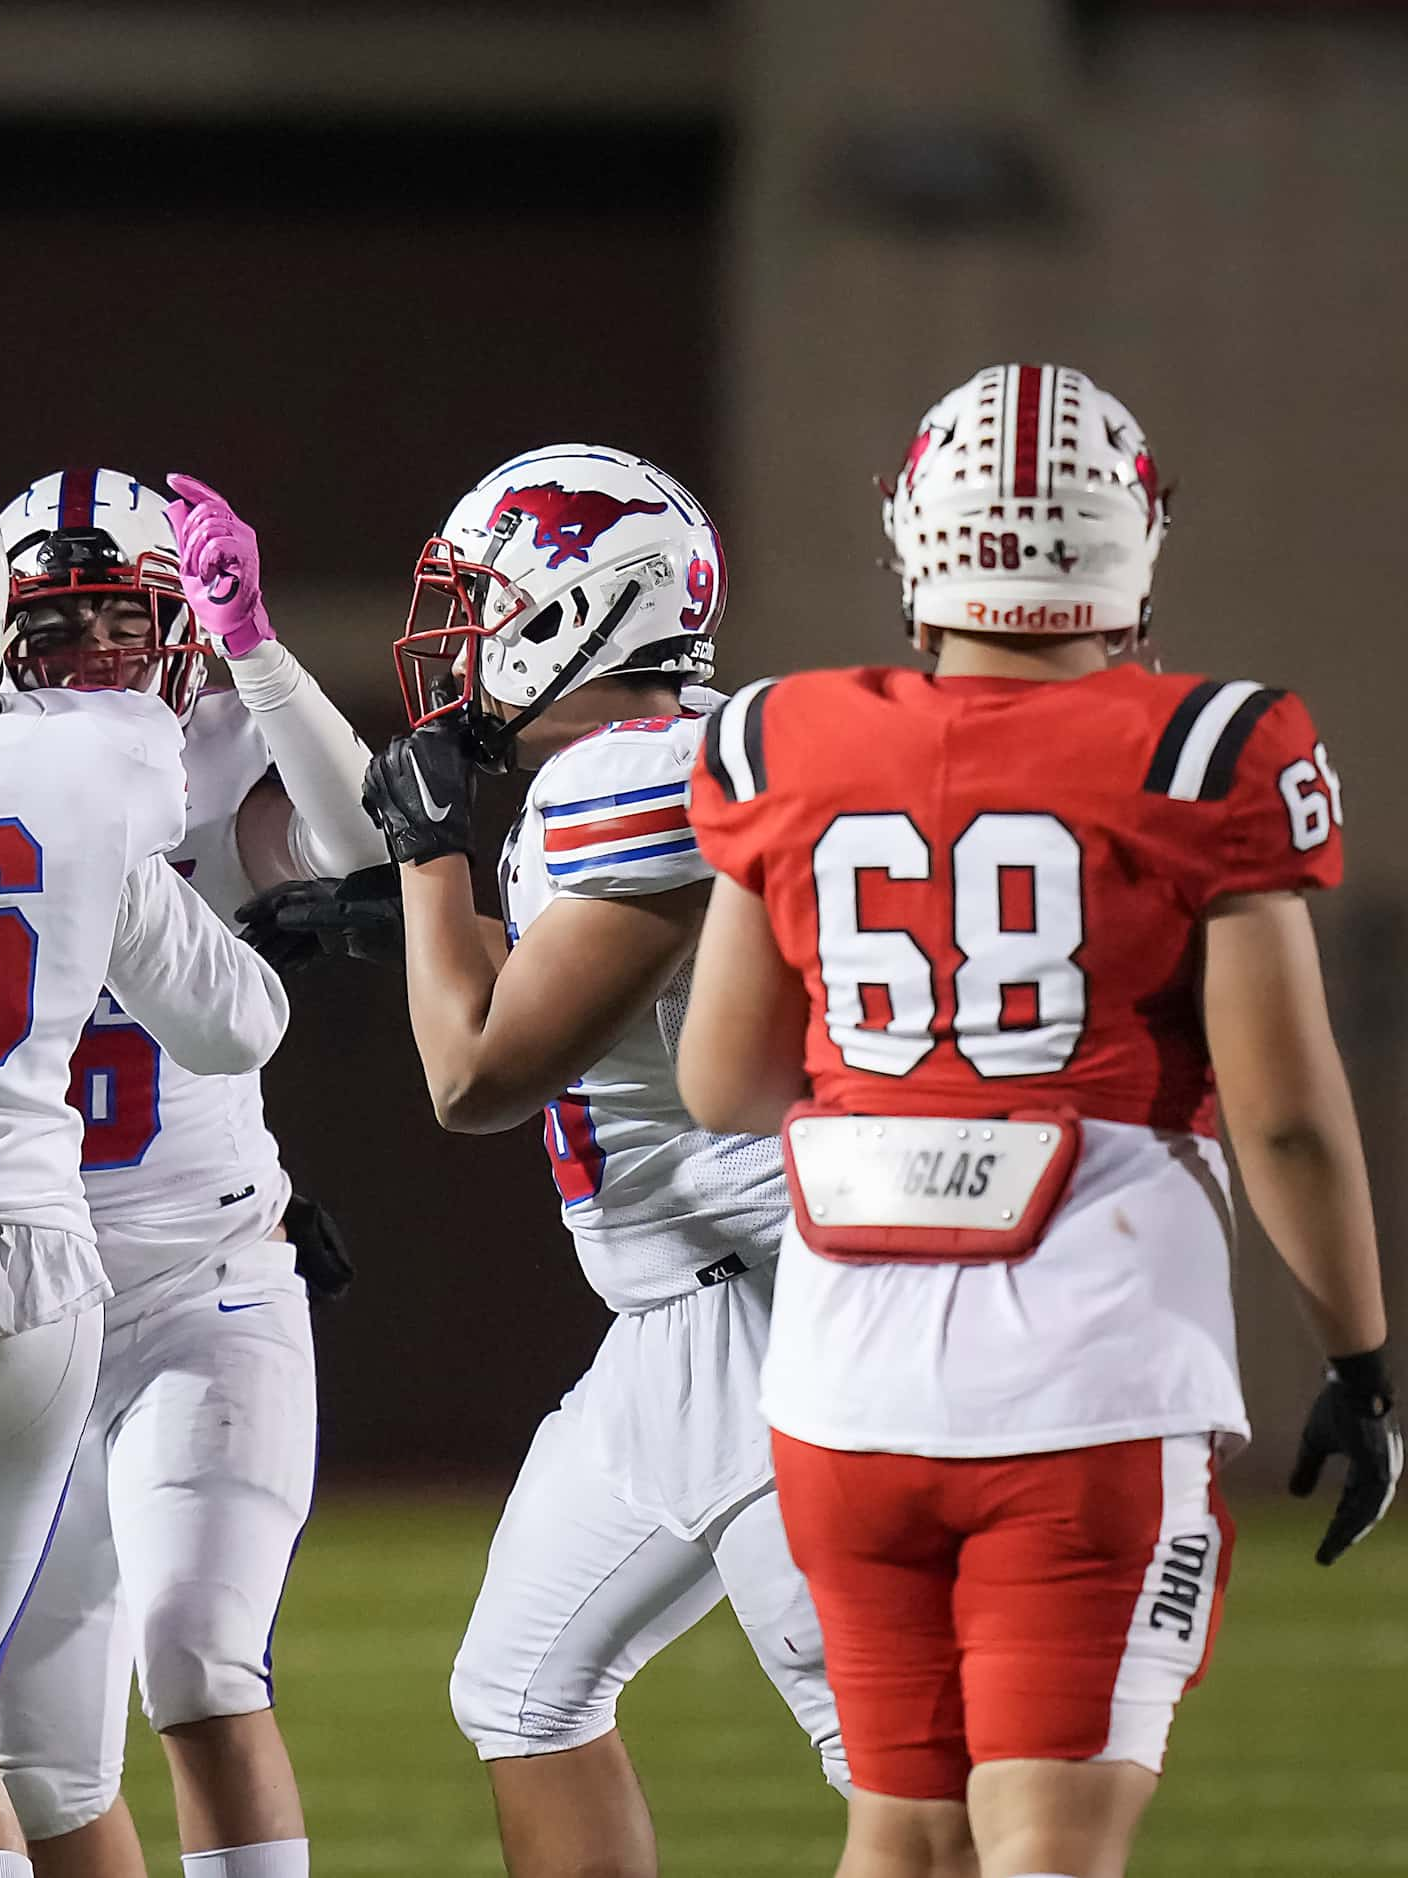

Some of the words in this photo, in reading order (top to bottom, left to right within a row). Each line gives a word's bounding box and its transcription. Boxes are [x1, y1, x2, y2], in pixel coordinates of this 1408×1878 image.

[979, 532, 1021, 570] 68
[679, 559, 714, 631] 9
[965, 602, 1093, 629] Riddell
[811, 811, 1088, 1080] 68
[708, 1266, 735, 1283] XL
